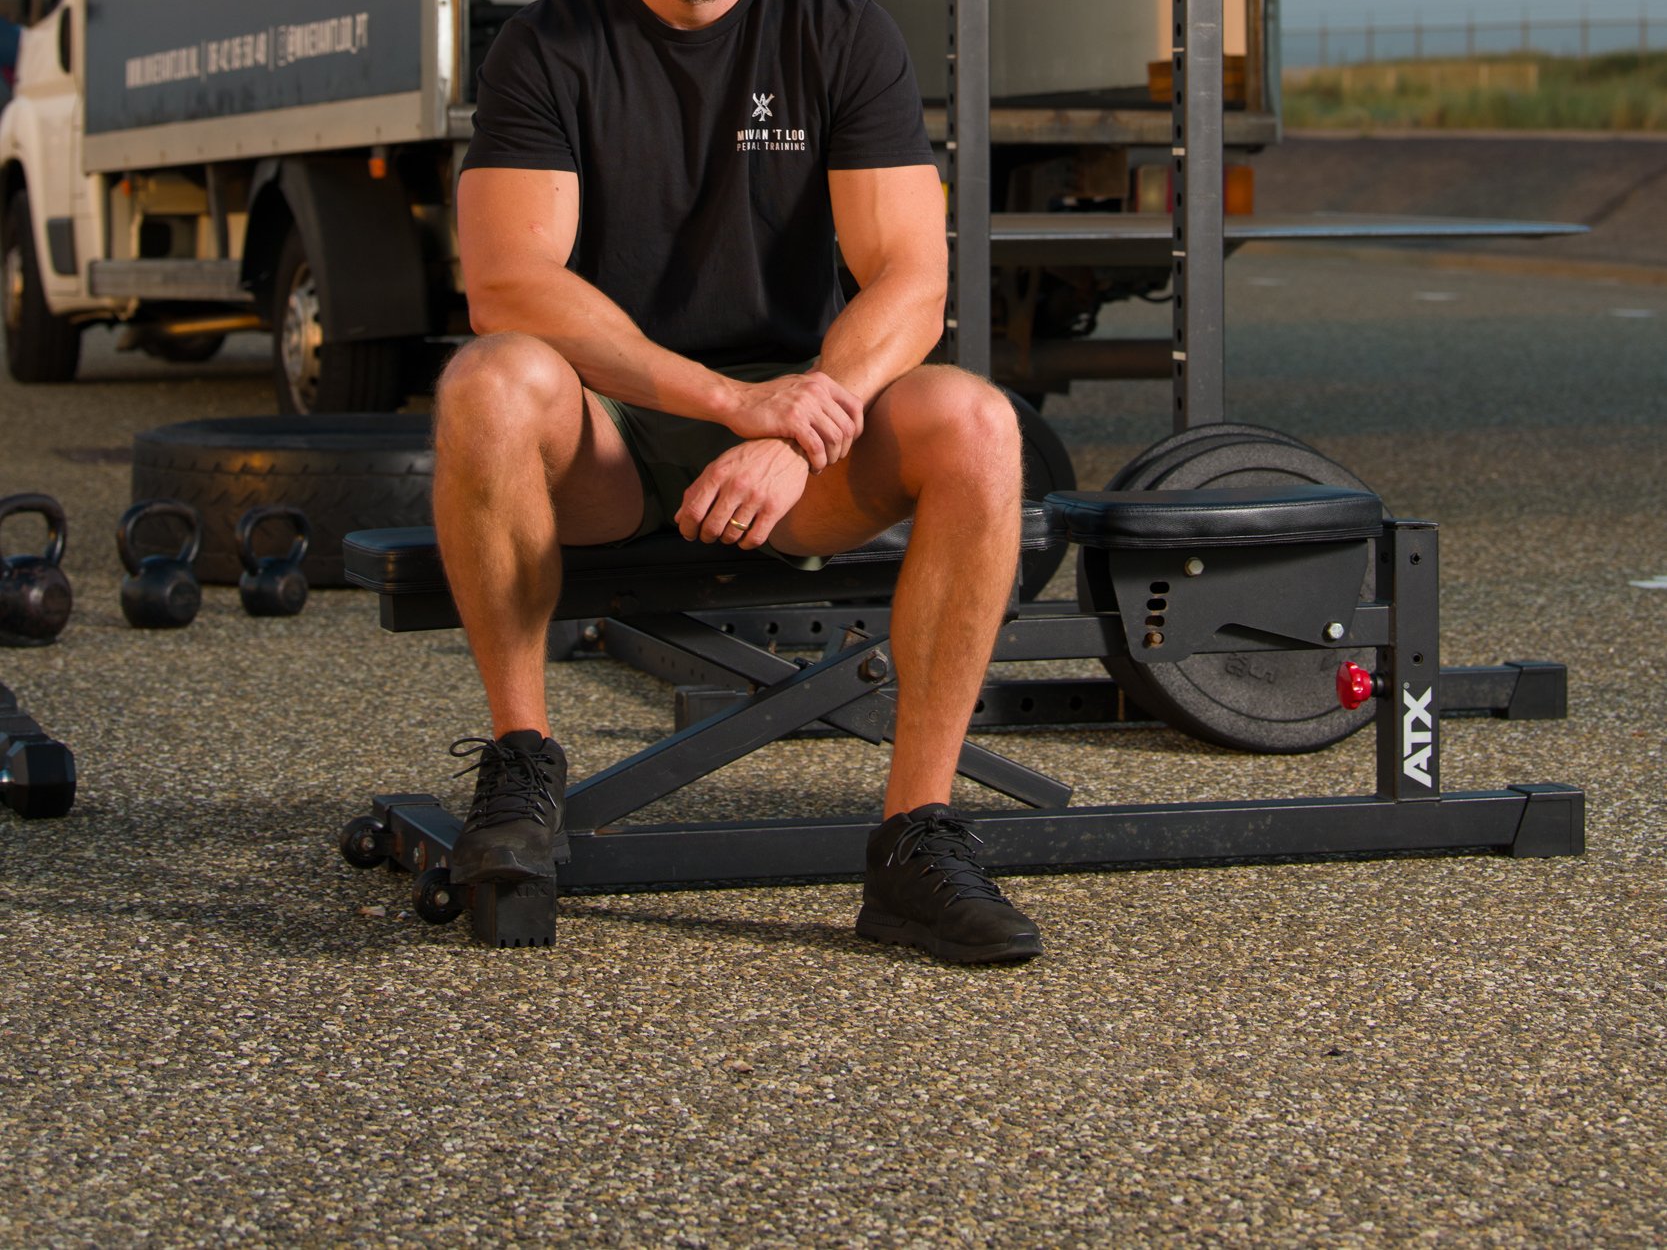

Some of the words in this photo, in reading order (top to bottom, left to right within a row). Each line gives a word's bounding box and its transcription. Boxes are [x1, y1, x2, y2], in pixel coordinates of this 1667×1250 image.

[786, 129, 805, 141] LOO
[765, 141, 805, 151] TRAINING
[1403, 686, 1432, 789] ATX
